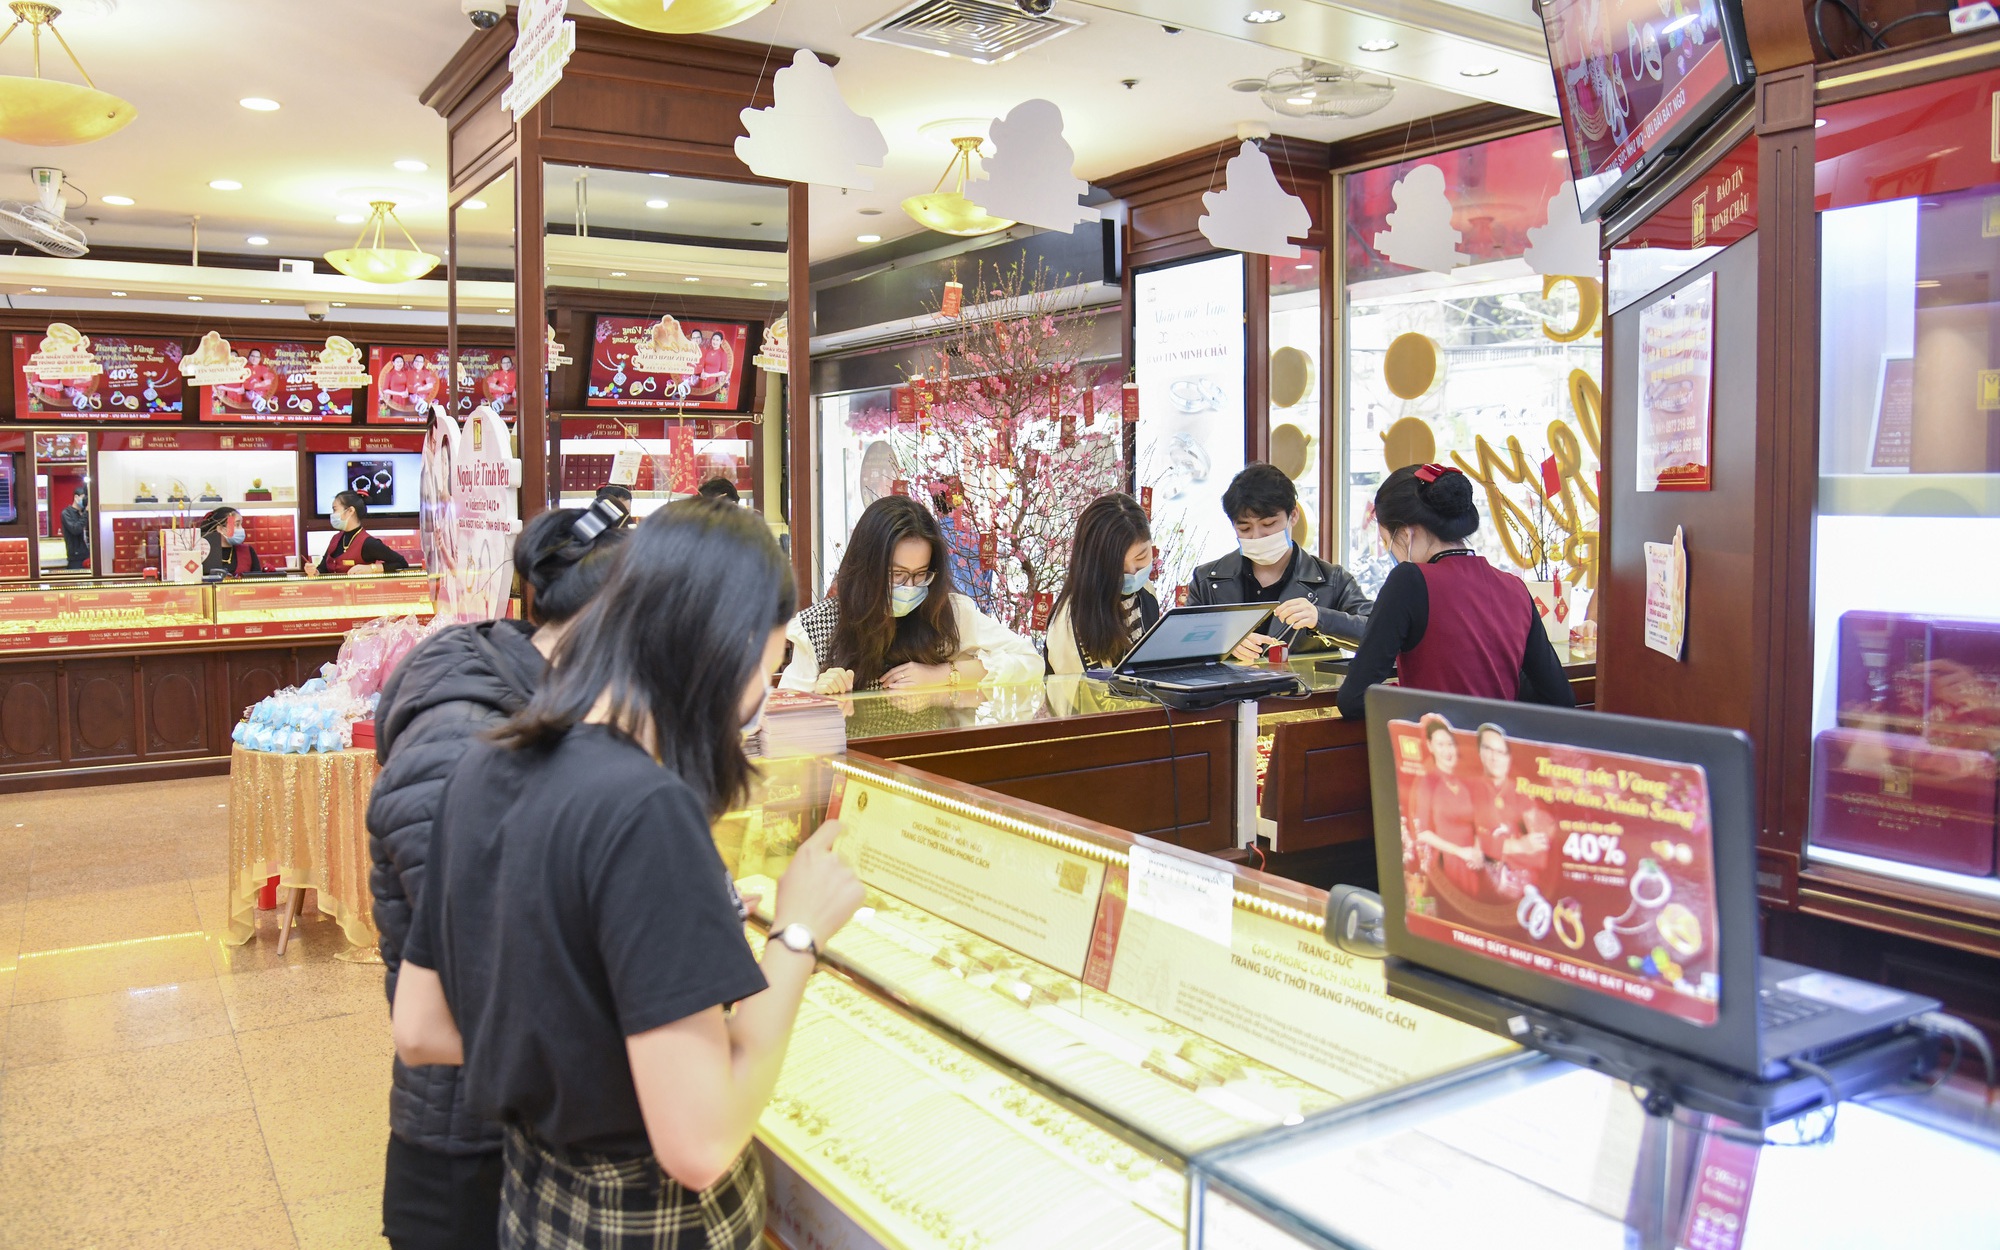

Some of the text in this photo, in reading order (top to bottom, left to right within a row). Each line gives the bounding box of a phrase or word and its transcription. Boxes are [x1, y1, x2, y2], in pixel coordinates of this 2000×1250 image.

[1716, 165, 1744, 203] BẢO TÍN
[1711, 191, 1749, 235] MINH CHÂU
[108, 368, 139, 380] 40%
[456, 459, 510, 493] Ngày lễ Tình Yêu
[1535, 756, 1668, 801] Trang sức Vàng
[1515, 776, 1555, 804] Rạng
[1603, 791, 1649, 819] Xuân
[1649, 800, 1697, 832] Sang
[901, 829, 917, 842] TRANG
[939, 842, 957, 858] TRANG
[956, 850, 974, 864] PHONG
[975, 854, 990, 869] CÁCH
[1562, 832, 1627, 866] 40%
[1252, 943, 1272, 959] CHO
[1273, 950, 1309, 972] PHONG
[1310, 961, 1339, 982] CÁCH
[1297, 940, 1356, 970] TRANG SỨC
[1452, 929, 1485, 950] TRANG
[1486, 939, 1508, 957] SỨC
[1509, 946, 1533, 965] NHƯ
[1624, 980, 1655, 1001] NGỜ
[1230, 952, 1418, 1032] TRANG SỨC THỜI TRANG PHONG CÁCH
